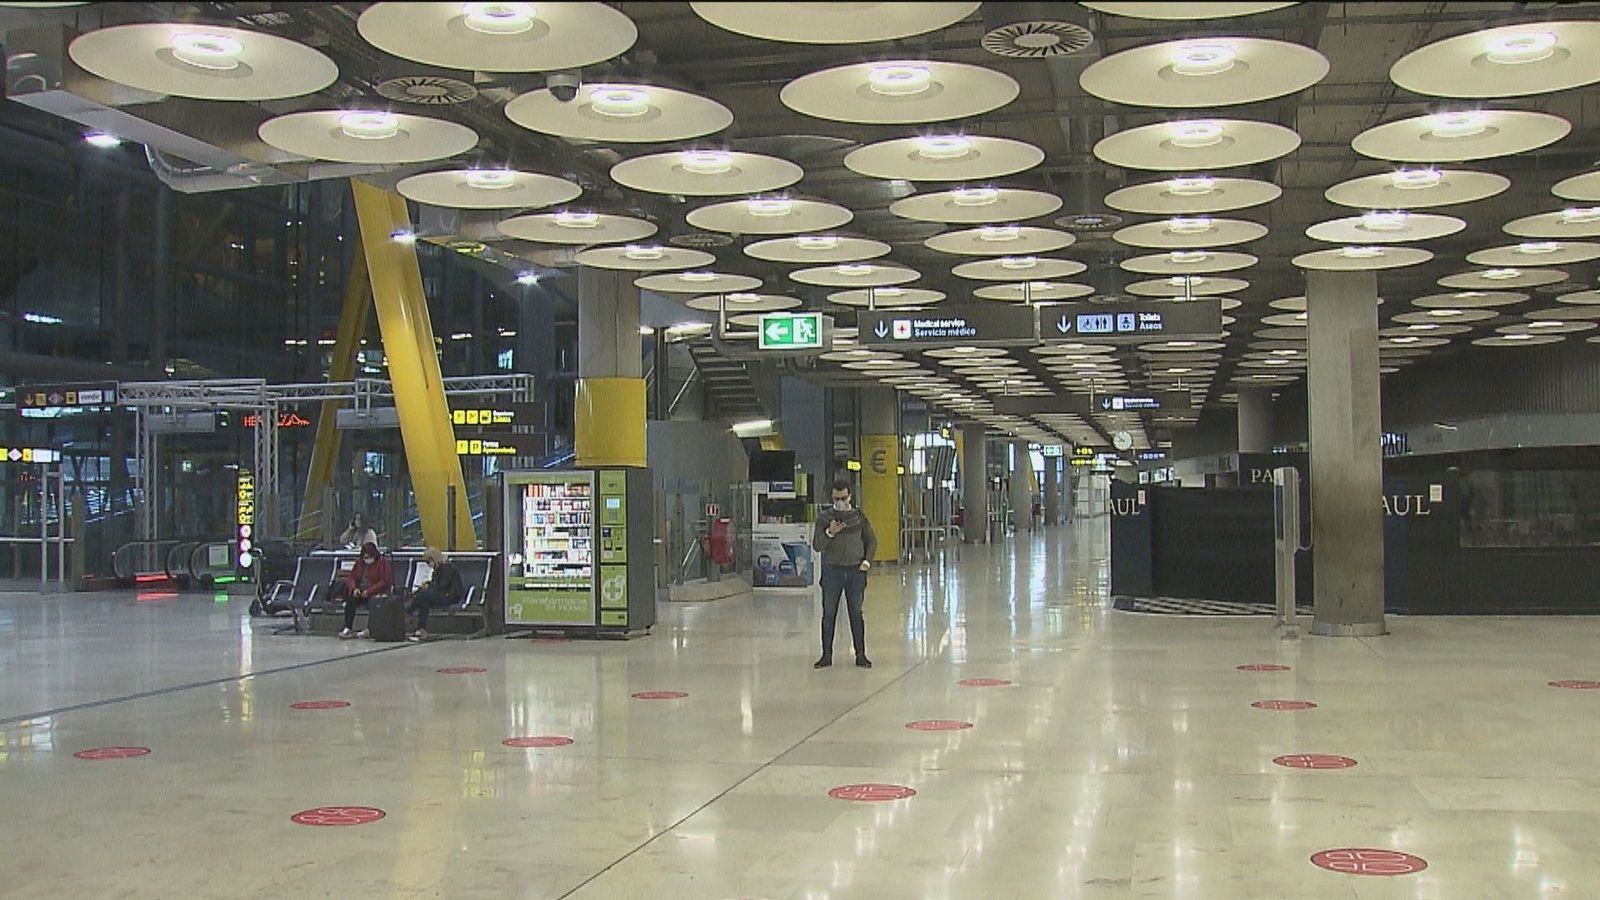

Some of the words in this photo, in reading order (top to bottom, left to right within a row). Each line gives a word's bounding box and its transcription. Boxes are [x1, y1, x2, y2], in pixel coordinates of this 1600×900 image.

[1138, 313, 1161, 321] Toilets
[913, 319, 939, 328] Medical
[1139, 322, 1162, 330] Aseos
[914, 328, 946, 337] Servicio
[947, 327, 976, 336] médico
[1110, 498, 1141, 516] AUL
[1382, 495, 1431, 516] AUL
